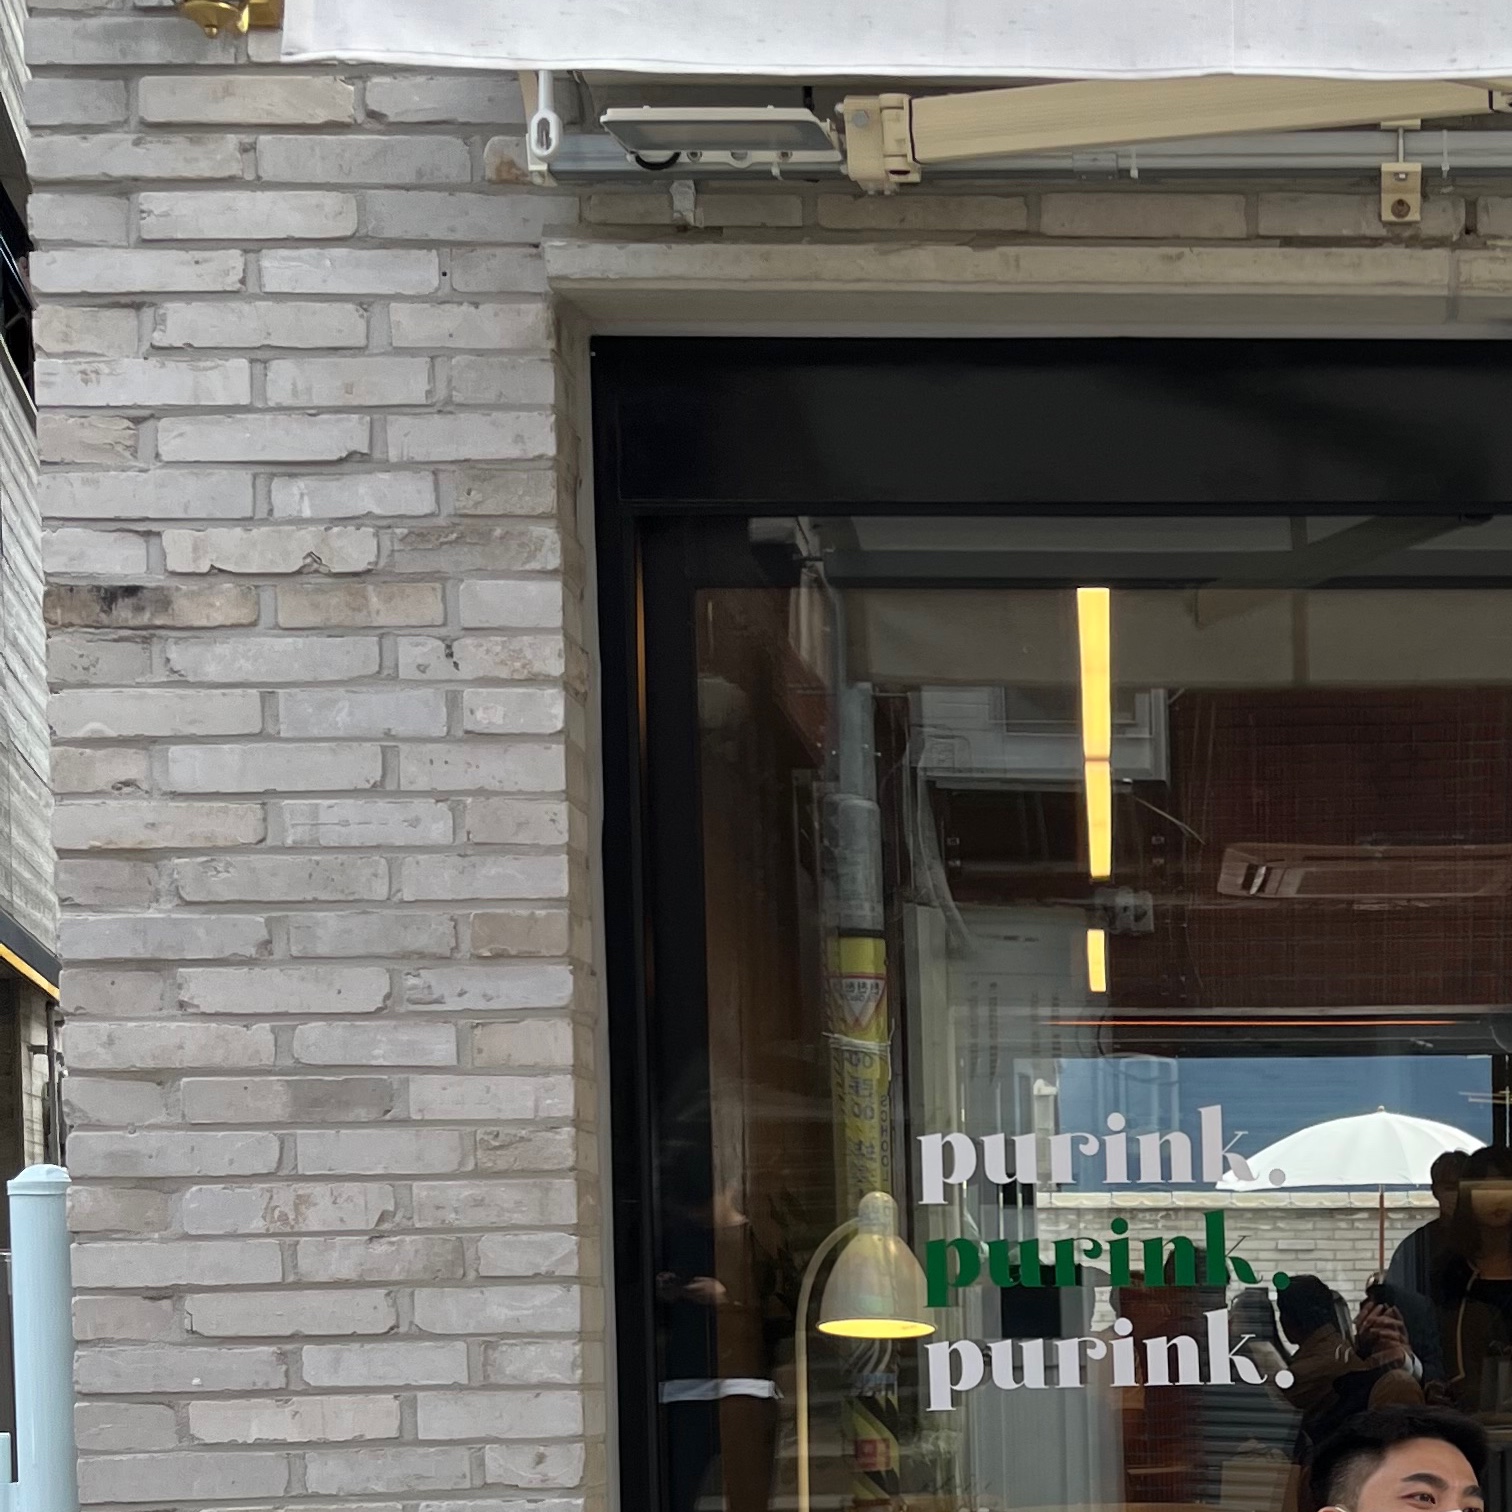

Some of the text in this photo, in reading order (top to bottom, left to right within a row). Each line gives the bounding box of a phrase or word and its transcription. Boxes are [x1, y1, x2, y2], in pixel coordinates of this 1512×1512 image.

[917, 1105, 1286, 1205] purink.
[925, 1210, 1291, 1308] purink.
[925, 1308, 1295, 1411] purink.
